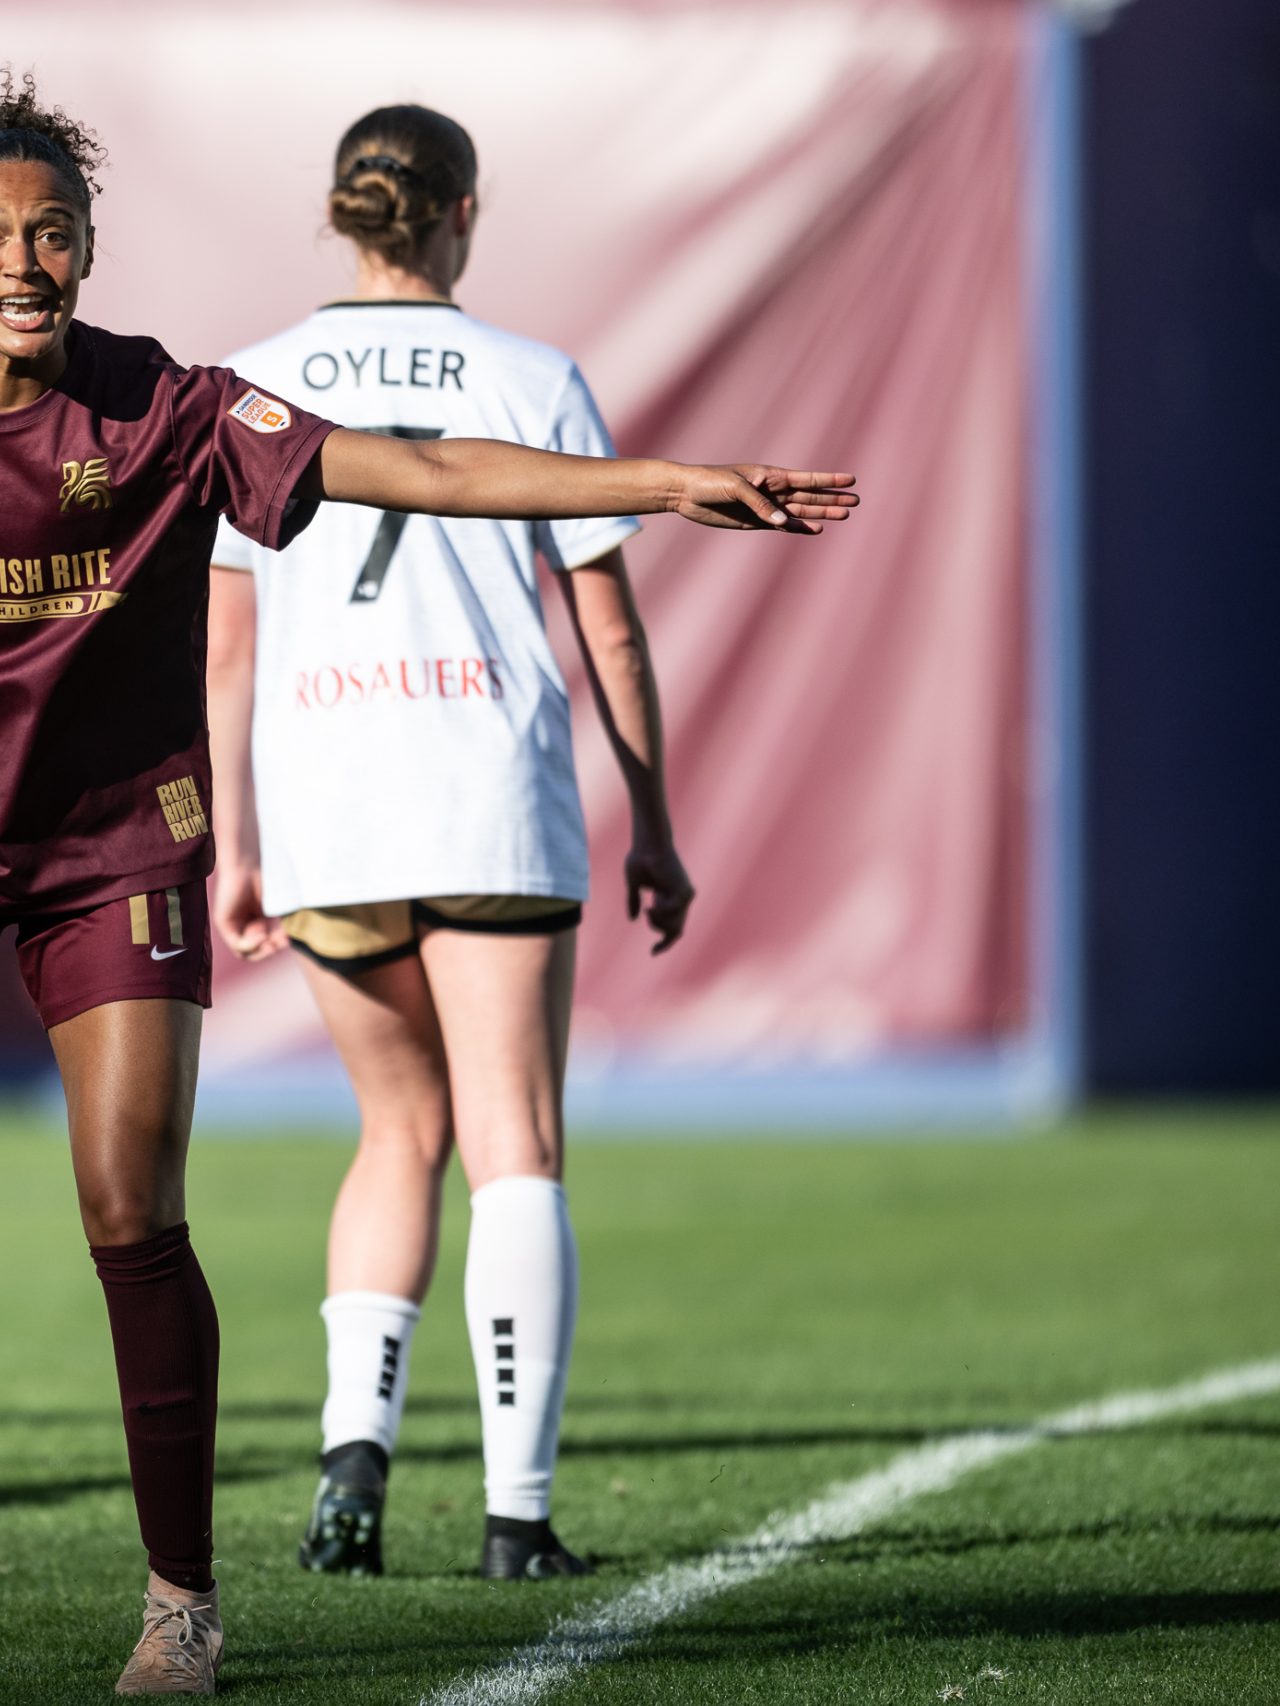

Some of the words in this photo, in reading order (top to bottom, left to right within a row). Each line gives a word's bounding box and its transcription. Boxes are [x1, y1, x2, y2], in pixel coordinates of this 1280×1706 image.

[303, 347, 466, 391] OYLER
[241, 398, 264, 419] SUPER
[51, 548, 111, 590] RITE
[296, 657, 504, 709] ROSAUERS
[156, 775, 197, 807] RUN
[162, 795, 203, 825] RIVER
[169, 813, 209, 843] RUN
[129, 887, 183, 945] 11
